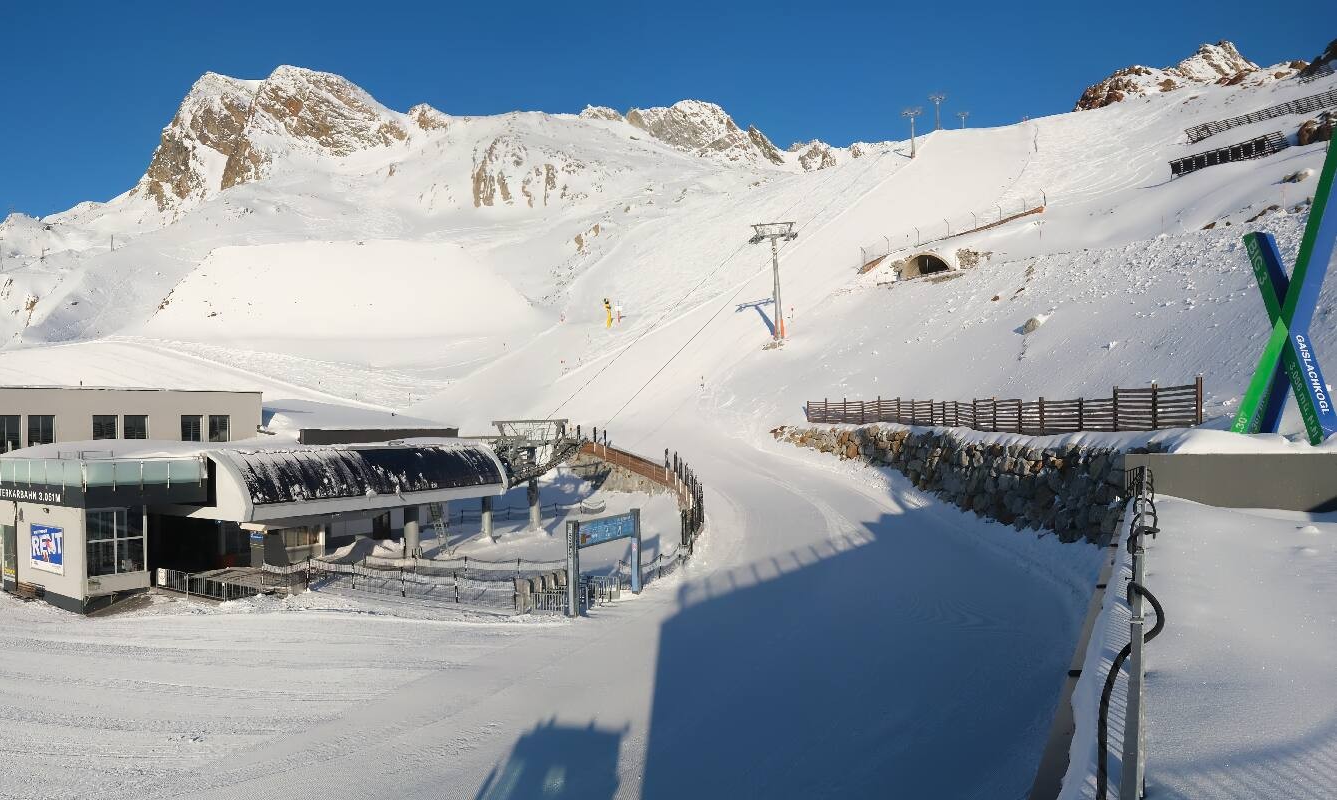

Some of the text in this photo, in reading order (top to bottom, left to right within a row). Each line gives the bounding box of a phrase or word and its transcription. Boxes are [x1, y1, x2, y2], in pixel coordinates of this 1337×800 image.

[1248, 238, 1268, 286] BIG 3
[1295, 334, 1330, 416] GAISLACHKOGL
[31, 532, 63, 557] RENT
